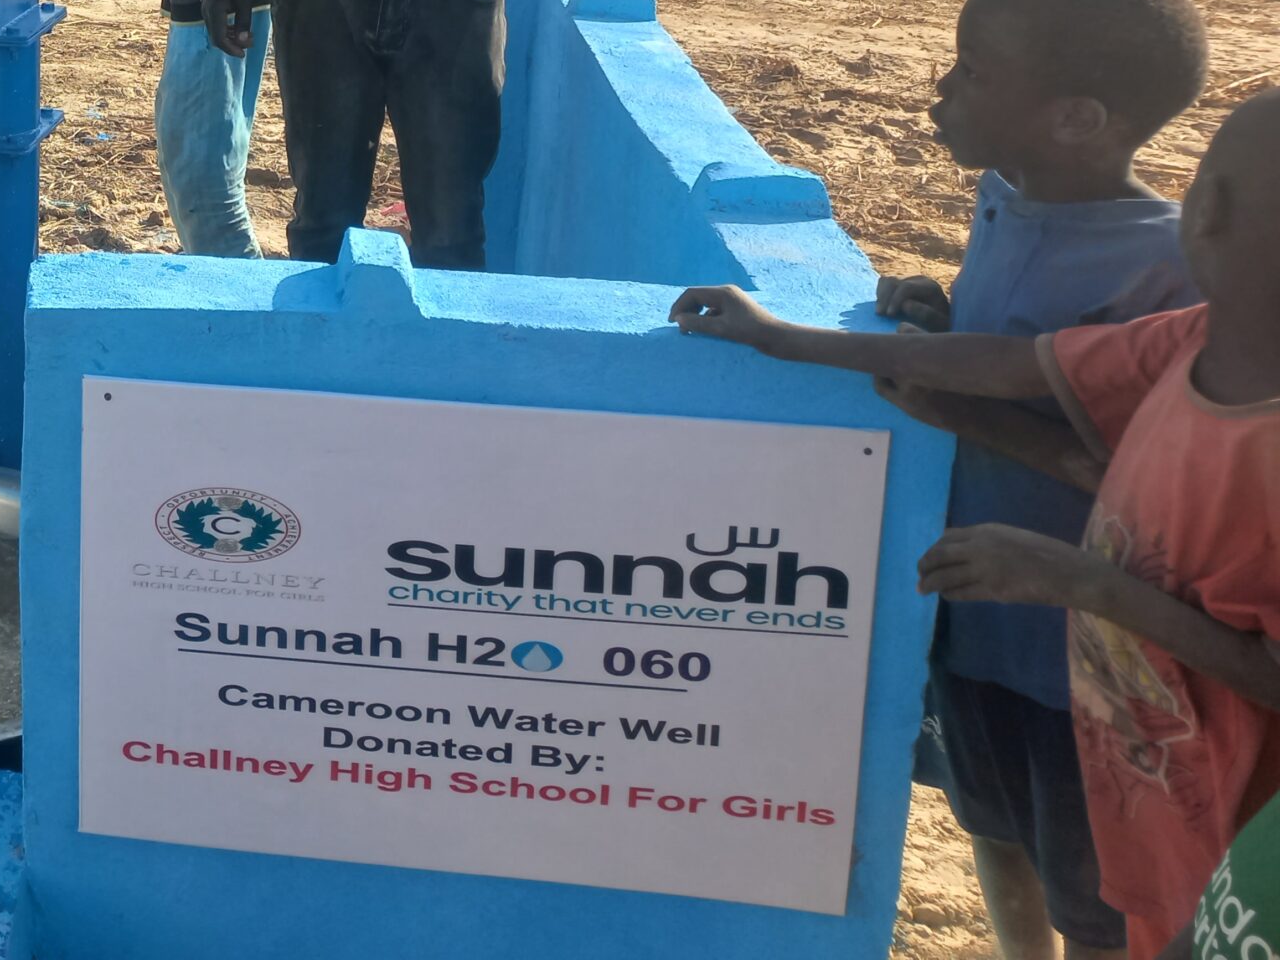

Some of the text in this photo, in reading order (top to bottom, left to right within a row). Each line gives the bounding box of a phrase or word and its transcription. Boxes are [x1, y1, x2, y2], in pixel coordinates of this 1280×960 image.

[166, 489, 266, 509] OPPORTUNITY
[159, 525, 206, 557] RESPECT
[211, 516, 241, 535] C
[248, 513, 297, 561] ACHIEVEMENT
[131, 562, 326, 590] CHALLNEY
[132, 580, 326, 603] HIGH SCHOOL FOR GIRLS
[384, 540, 850, 610] sunnah
[387, 583, 846, 630] charity that never ends
[174, 612, 403, 659] Sunnah
[603, 646, 712, 682] 060
[217, 684, 721, 747] Cameroon Water Well
[322, 726, 605, 776] Donated By:
[122, 740, 836, 826] Challney High School For Girls
